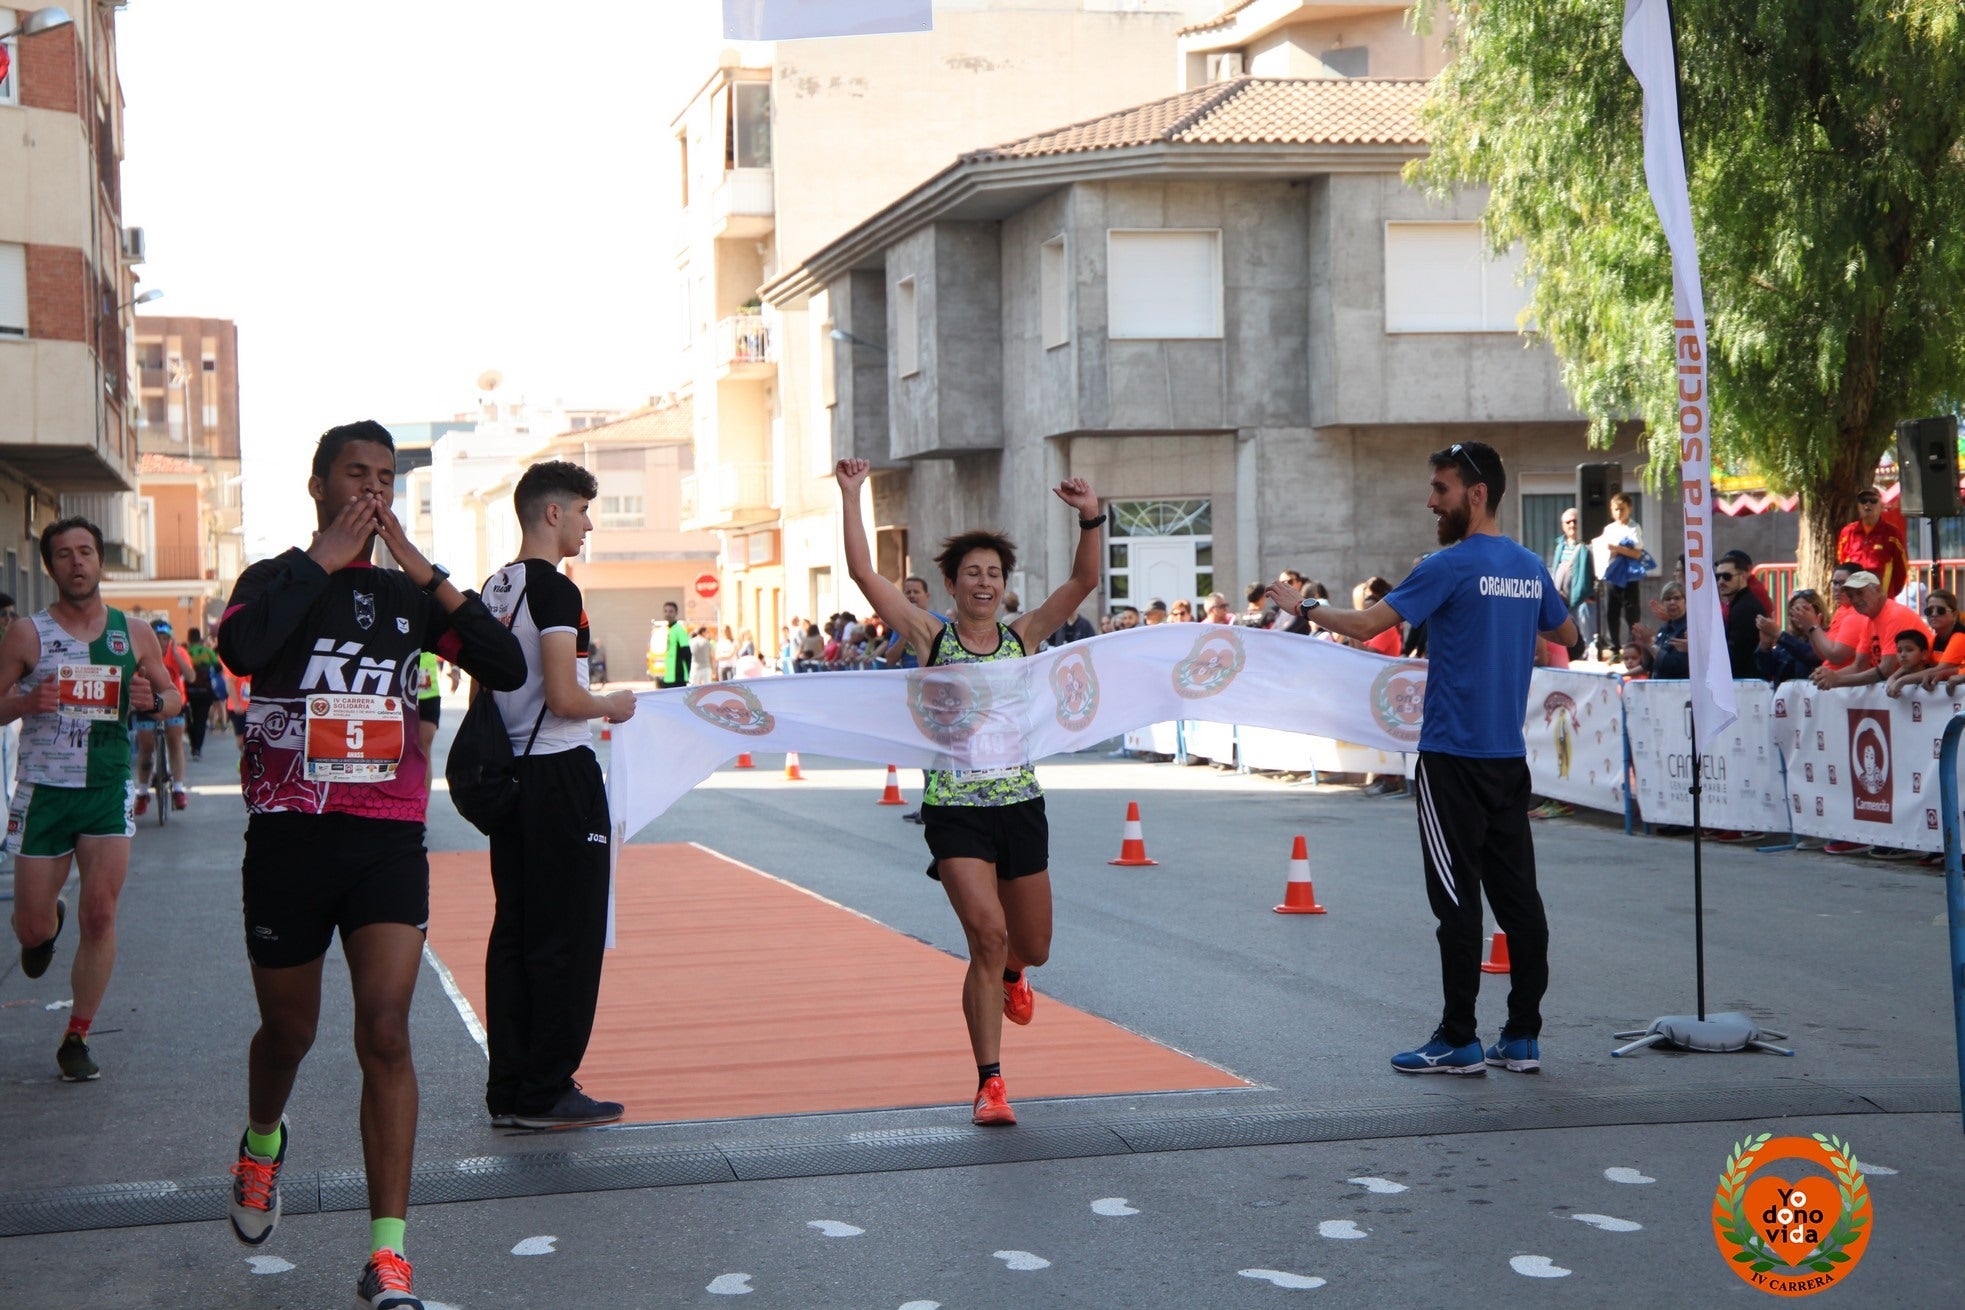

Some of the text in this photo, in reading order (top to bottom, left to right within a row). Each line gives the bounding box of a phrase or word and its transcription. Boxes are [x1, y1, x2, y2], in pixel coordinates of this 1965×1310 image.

[1675, 319, 1704, 463] social
[72, 681, 105, 700] 418
[346, 720, 365, 750] 5
[1667, 753, 1727, 781] CANELA
